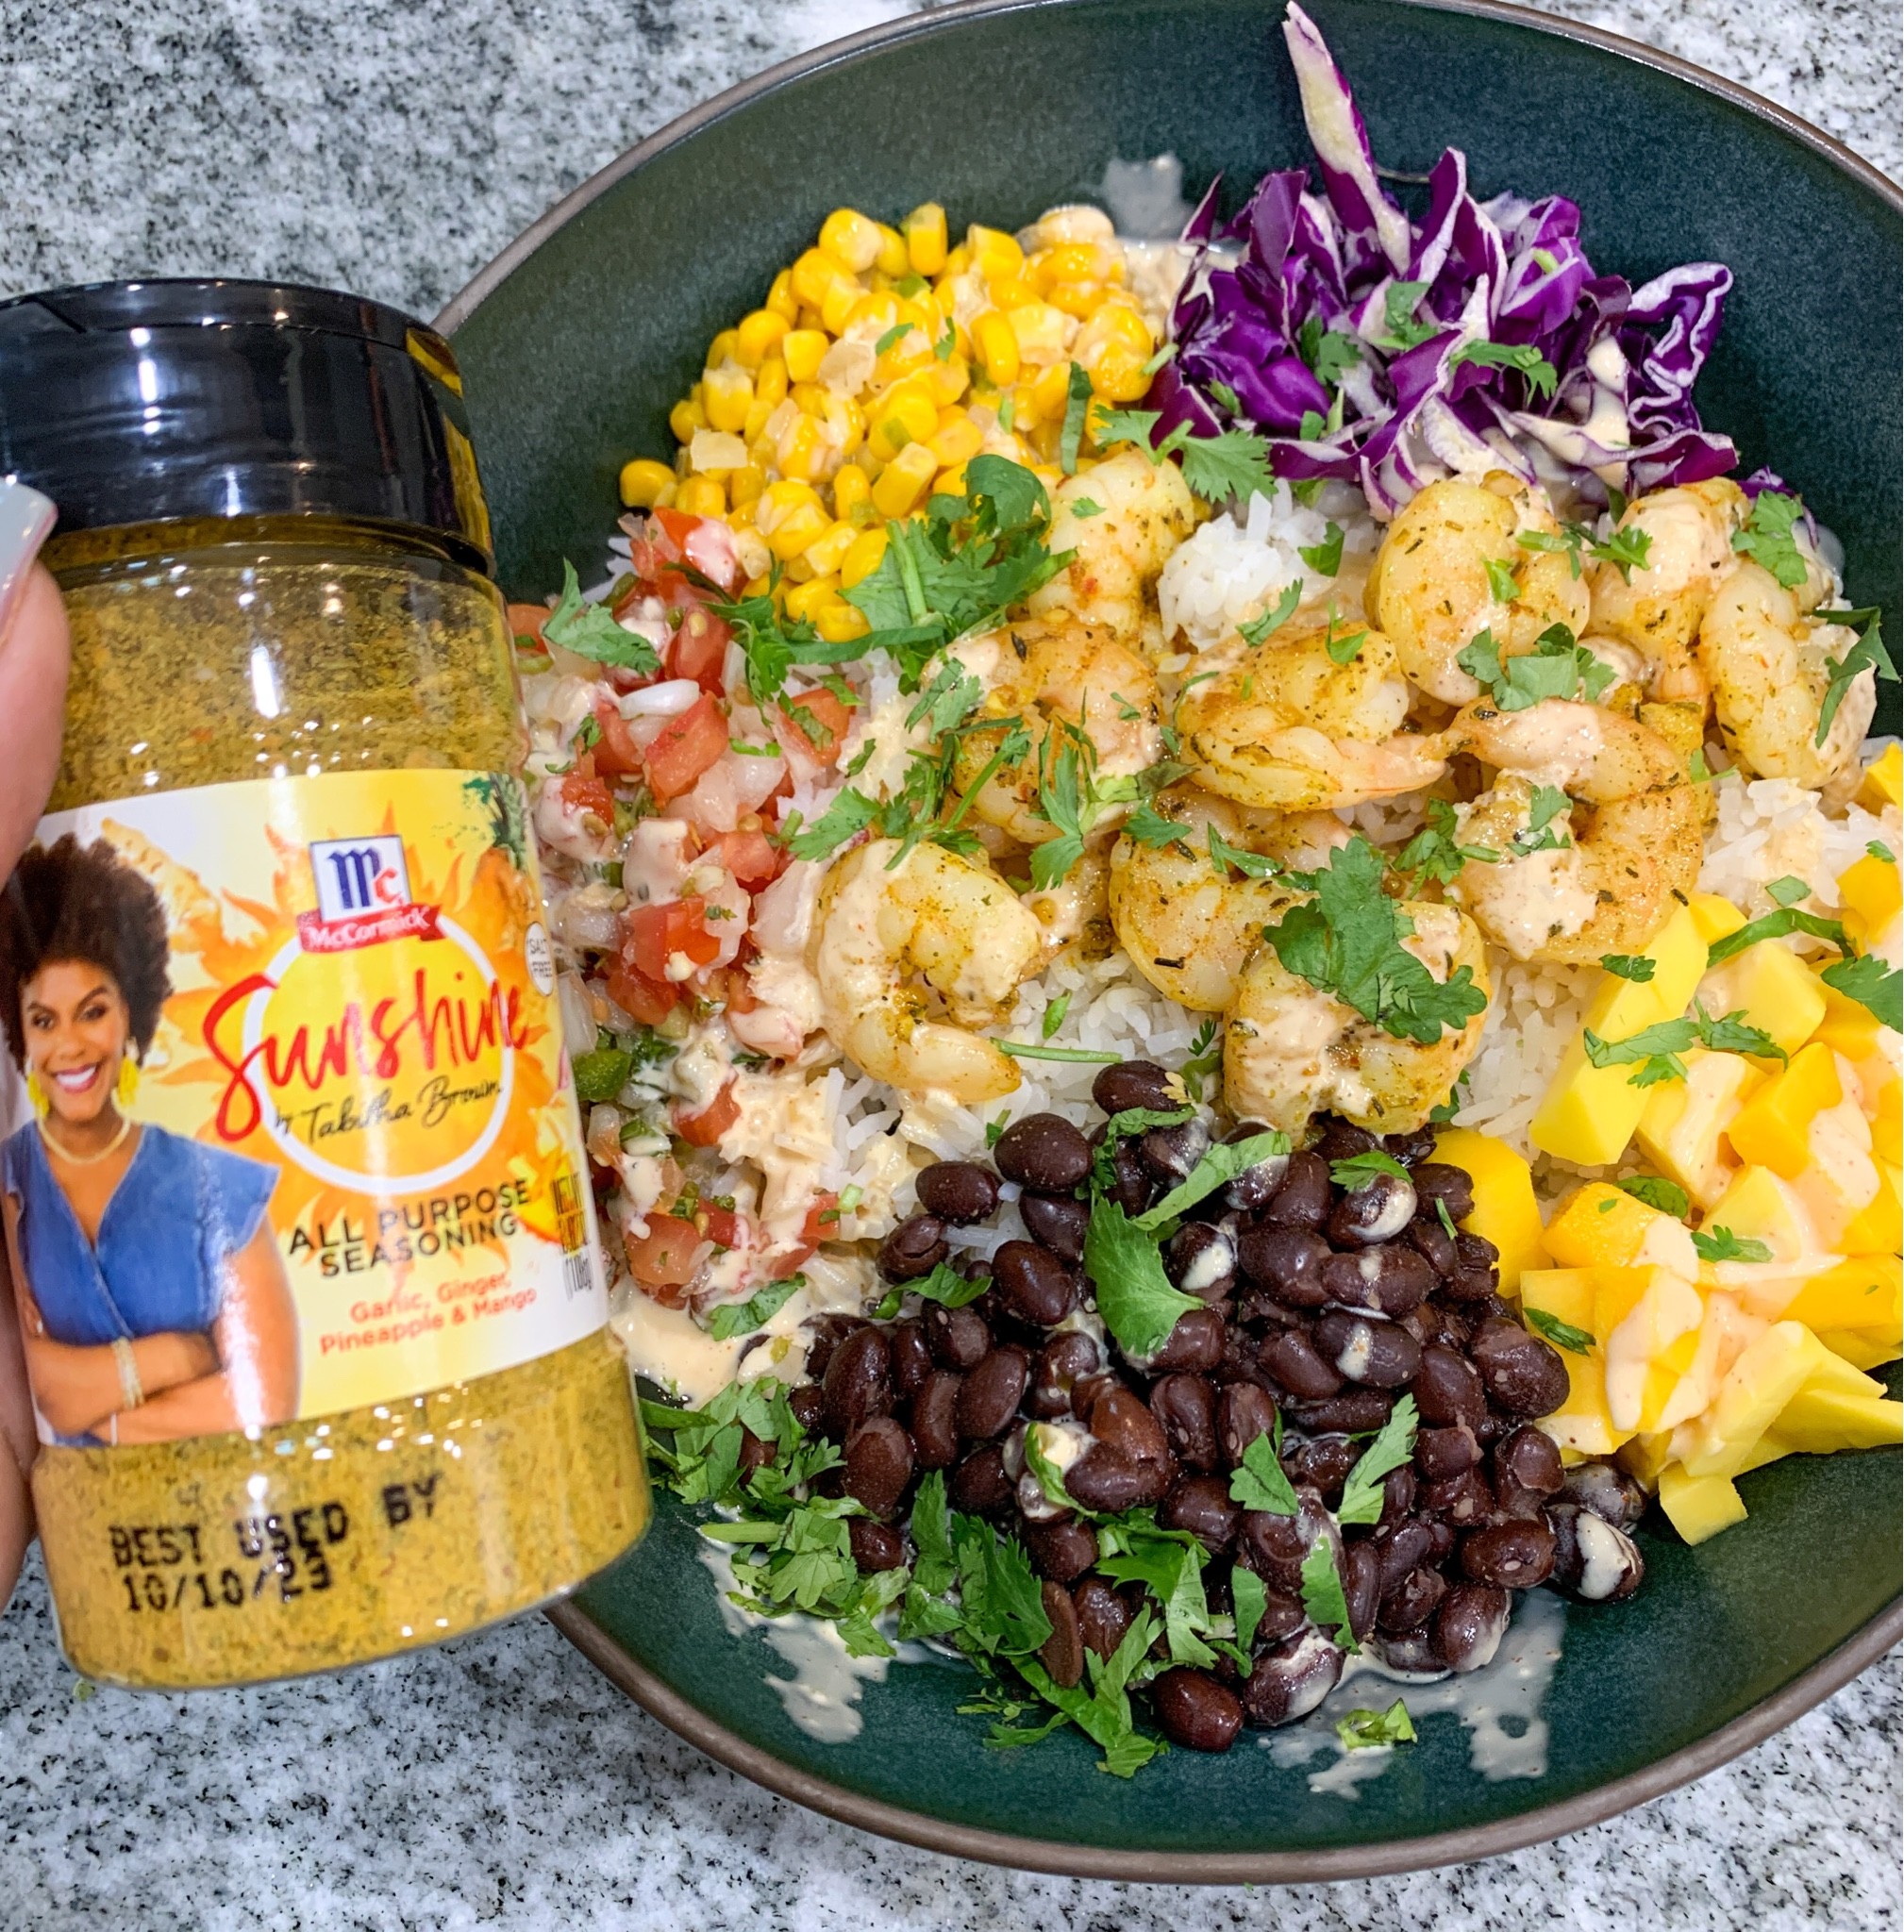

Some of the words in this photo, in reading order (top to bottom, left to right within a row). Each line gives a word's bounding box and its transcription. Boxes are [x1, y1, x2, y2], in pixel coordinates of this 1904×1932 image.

[303, 906, 431, 949] McCormick
[202, 967, 529, 1141] Sunshine
[300, 1087, 413, 1145] Tabitha
[289, 1216, 364, 1255] ALL
[379, 1178, 529, 1237] PURPOSE
[320, 1213, 518, 1277] SEASONING
[320, 1312, 444, 1356] Pineapple
[450, 1305, 467, 1325] &
[473, 1287, 537, 1320] Mango
[109, 1522, 200, 1567] BEST
[234, 1501, 349, 1557] USED
[381, 1470, 444, 1528] BY
[124, 1546, 333, 1611] 10/10/23
